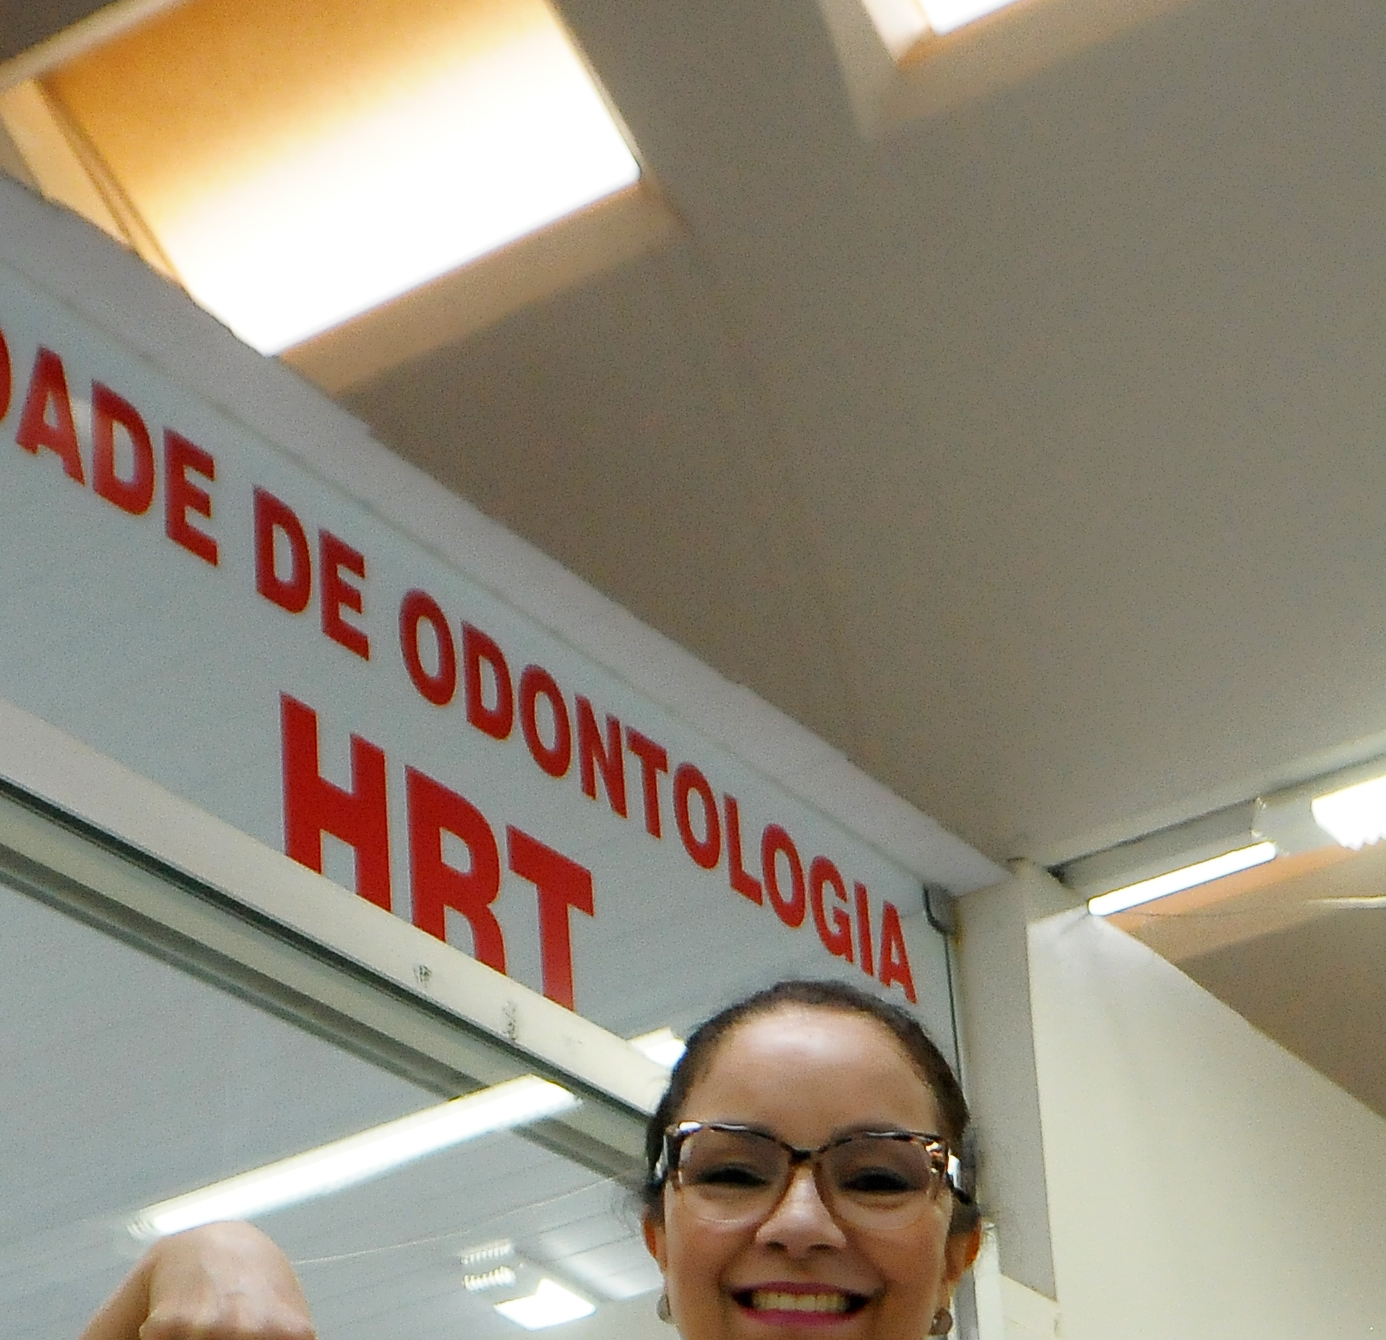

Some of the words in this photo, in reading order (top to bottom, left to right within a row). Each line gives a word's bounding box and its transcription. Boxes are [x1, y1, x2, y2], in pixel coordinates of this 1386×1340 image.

[253, 485, 369, 661] DE
[399, 587, 917, 1004] ODONTOLOGIA
[279, 690, 594, 1012] HRT
